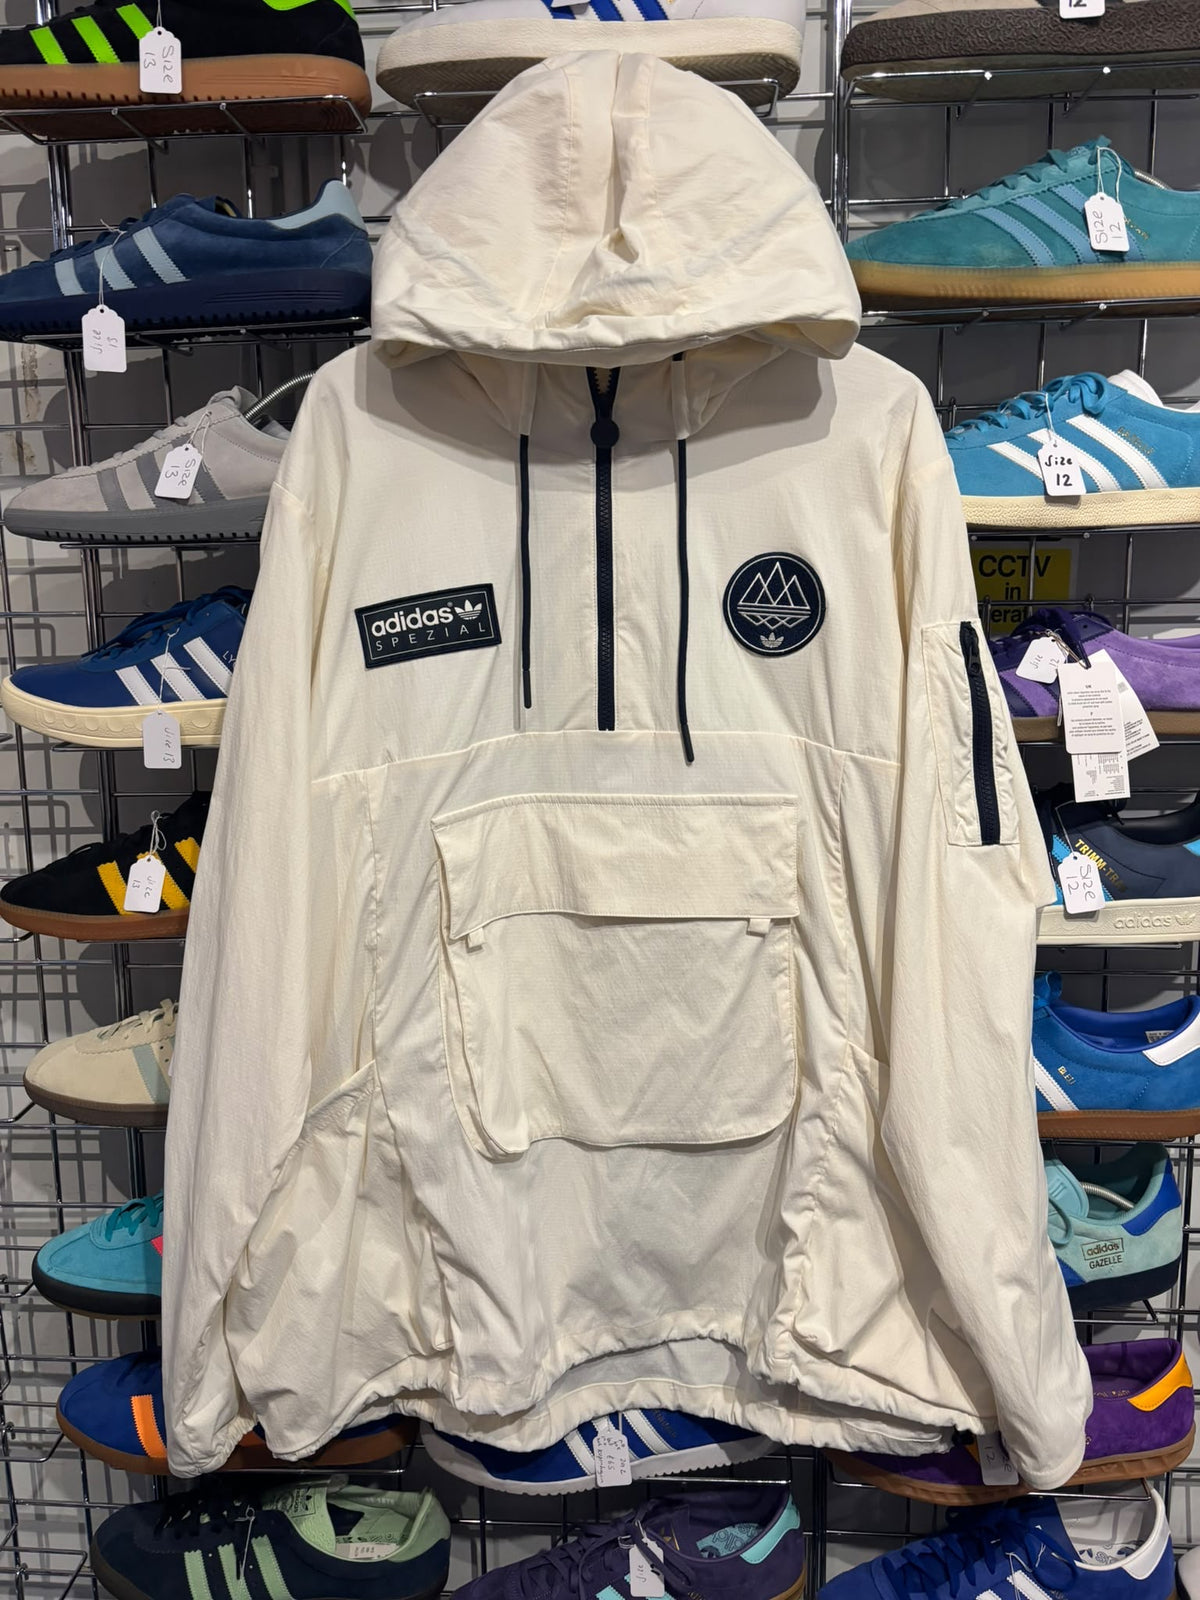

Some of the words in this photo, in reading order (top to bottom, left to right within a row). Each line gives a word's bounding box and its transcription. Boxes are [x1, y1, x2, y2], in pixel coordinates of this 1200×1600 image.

[143, 51, 157, 70] 13
[1108, 221, 1124, 239] 12
[1044, 454, 1074, 467] Size
[164, 465, 181, 479] 13
[1056, 473, 1073, 487] 12
[978, 554, 1052, 577] CCTV
[1005, 582, 1021, 601] in
[371, 606, 455, 638] adidas
[375, 622, 486, 652] SPEZIAL
[1065, 875, 1080, 895] 12
[1113, 911, 1173, 930] adidas
[1086, 1242, 1120, 1256] adidas
[1088, 1254, 1124, 1270] GAZELLE
